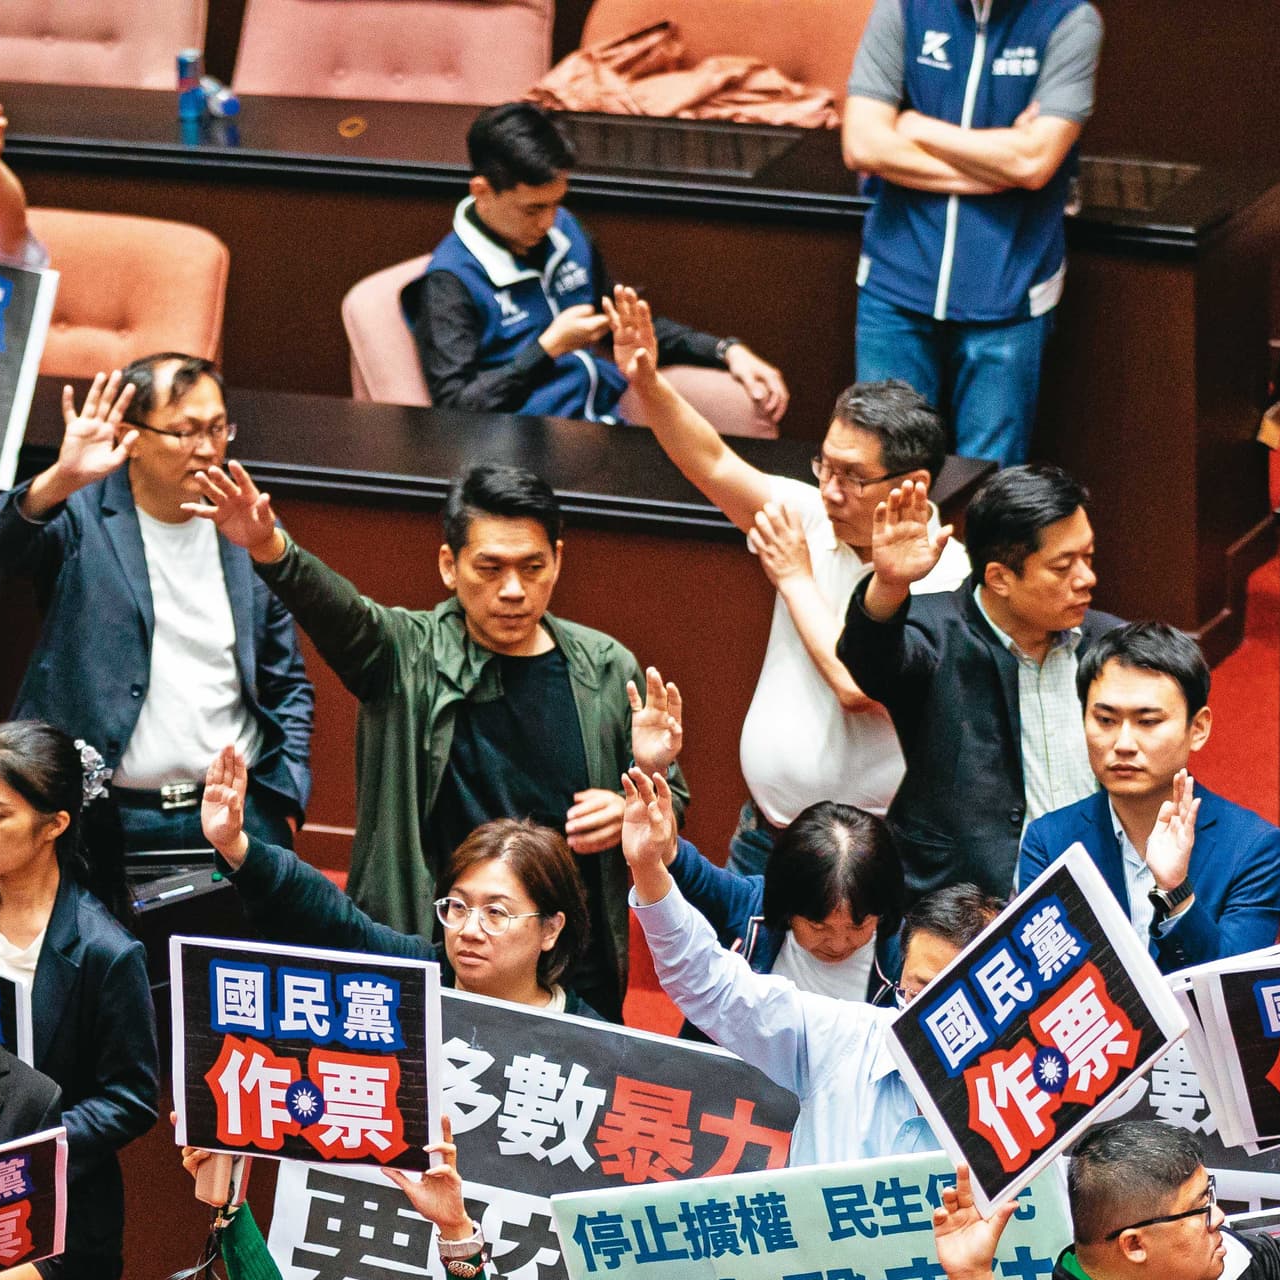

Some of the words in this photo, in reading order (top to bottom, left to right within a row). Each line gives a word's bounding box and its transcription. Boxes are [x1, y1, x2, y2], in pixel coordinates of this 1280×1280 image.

[215, 965, 394, 1044] 國民黨
[925, 903, 1082, 1070] 國民黨
[218, 1047, 395, 1151] 作票
[974, 975, 1130, 1162] 作票
[572, 1191, 798, 1273] 停止擴權
[821, 1172, 1036, 1241] 民生
